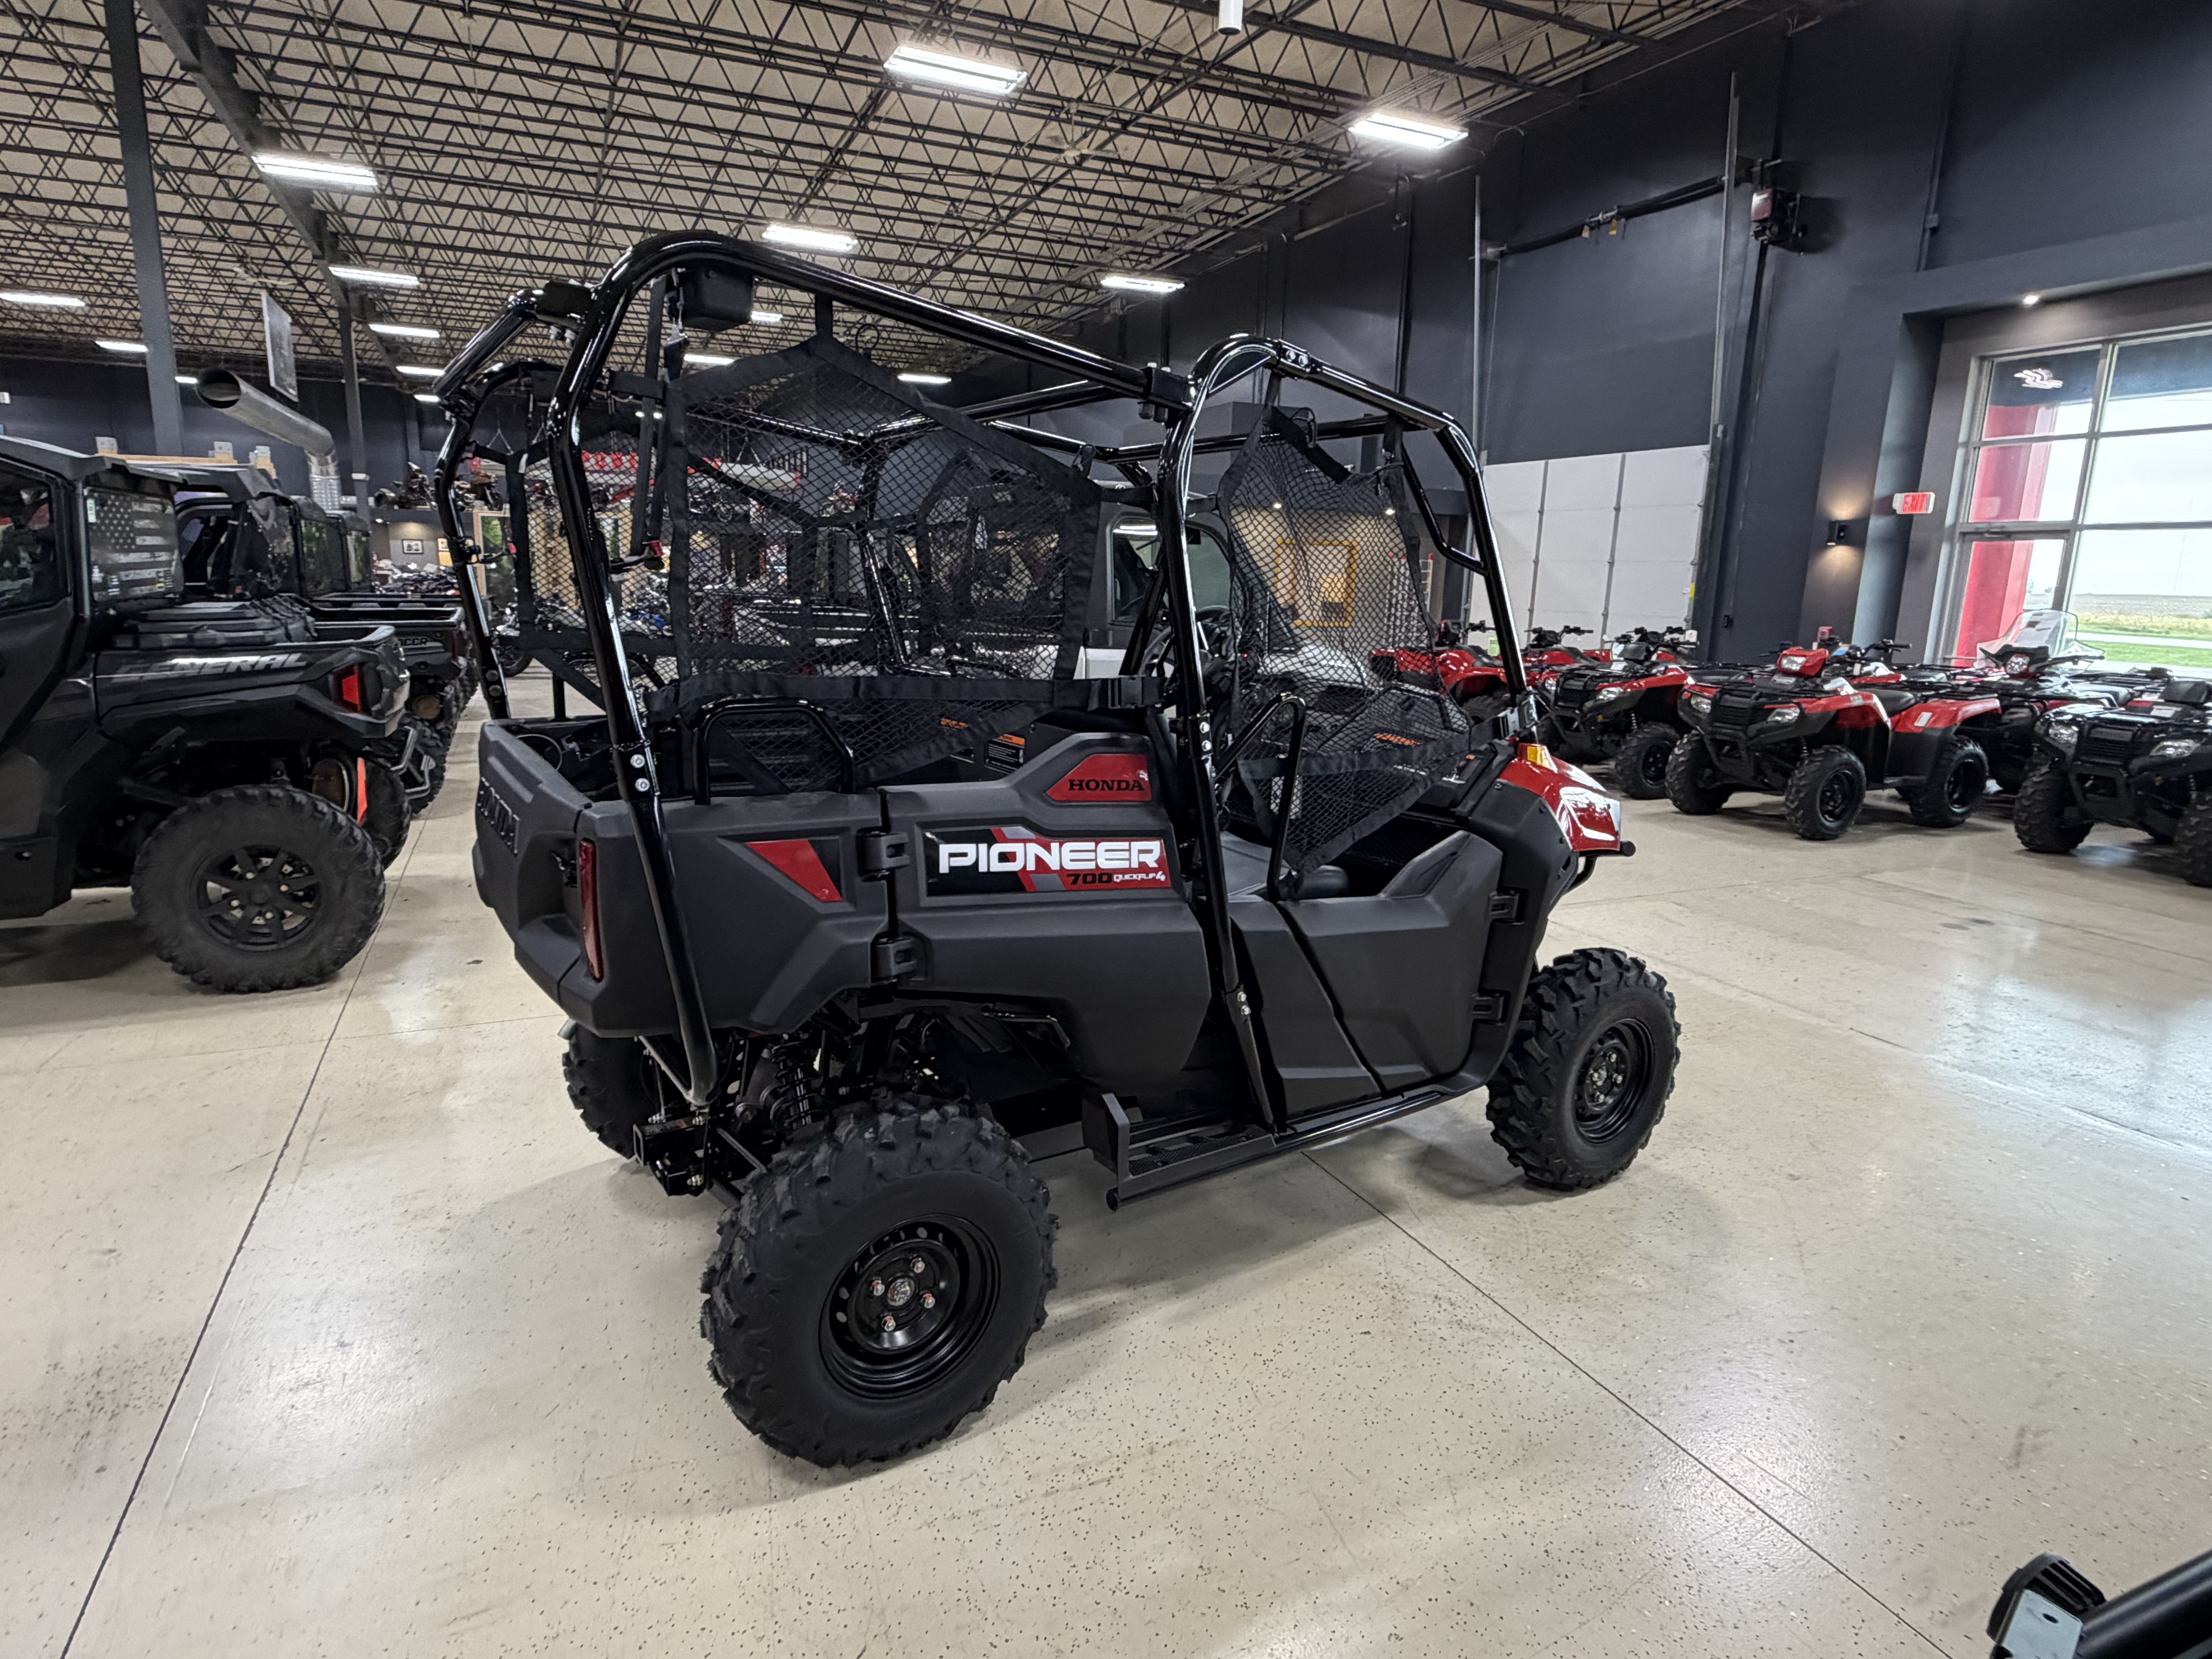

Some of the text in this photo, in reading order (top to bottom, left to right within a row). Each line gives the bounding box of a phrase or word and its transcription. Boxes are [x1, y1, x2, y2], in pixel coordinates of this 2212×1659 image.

[1068, 779, 1144, 791] HONDA
[939, 842, 1160, 873] PIONEER
[1066, 872, 1112, 885] 700
